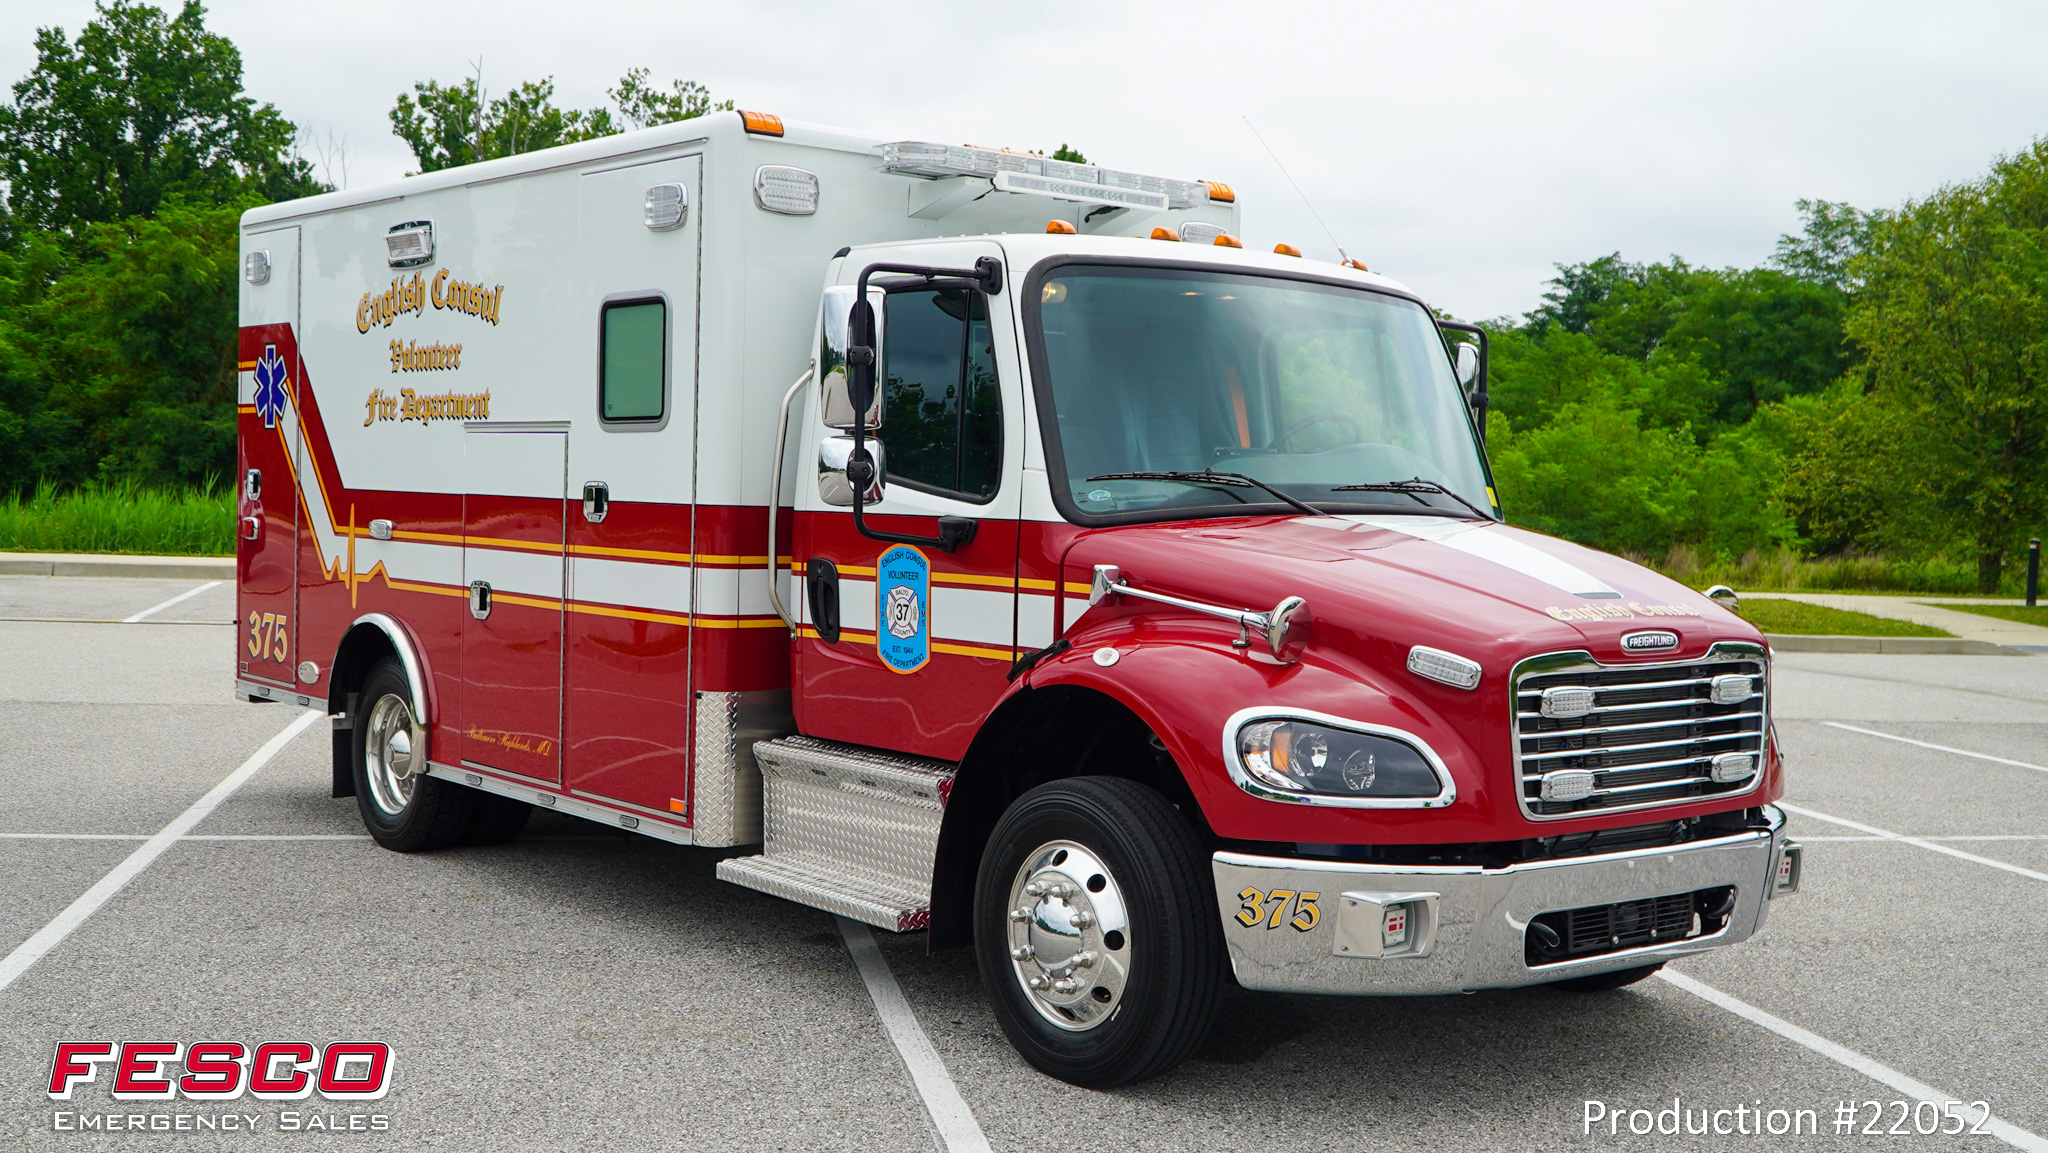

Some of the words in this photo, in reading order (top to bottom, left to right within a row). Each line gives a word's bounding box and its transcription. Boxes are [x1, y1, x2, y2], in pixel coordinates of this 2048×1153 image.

[356, 271, 426, 335] English
[430, 267, 504, 327] Consul
[389, 338, 463, 374] Volunteer
[363, 388, 398, 428] Fire
[400, 387, 491, 427] Department
[881, 550, 904, 568] ENGLISH
[905, 550, 926, 571] CONSUL
[887, 570, 919, 580] VOLUNTEER
[896, 603, 909, 621] 37
[1545, 602, 1635, 622] English
[1628, 602, 1700, 617] Consul
[247, 610, 288, 664] 375
[893, 627, 912, 636] COUNTY
[1629, 636, 1676, 648] FREIGHTLINER
[882, 649, 893, 663] FIRE
[893, 653, 925, 668] DEPARTMENT
[533, 740, 552, 756] MD
[1234, 886, 1322, 933] 375
